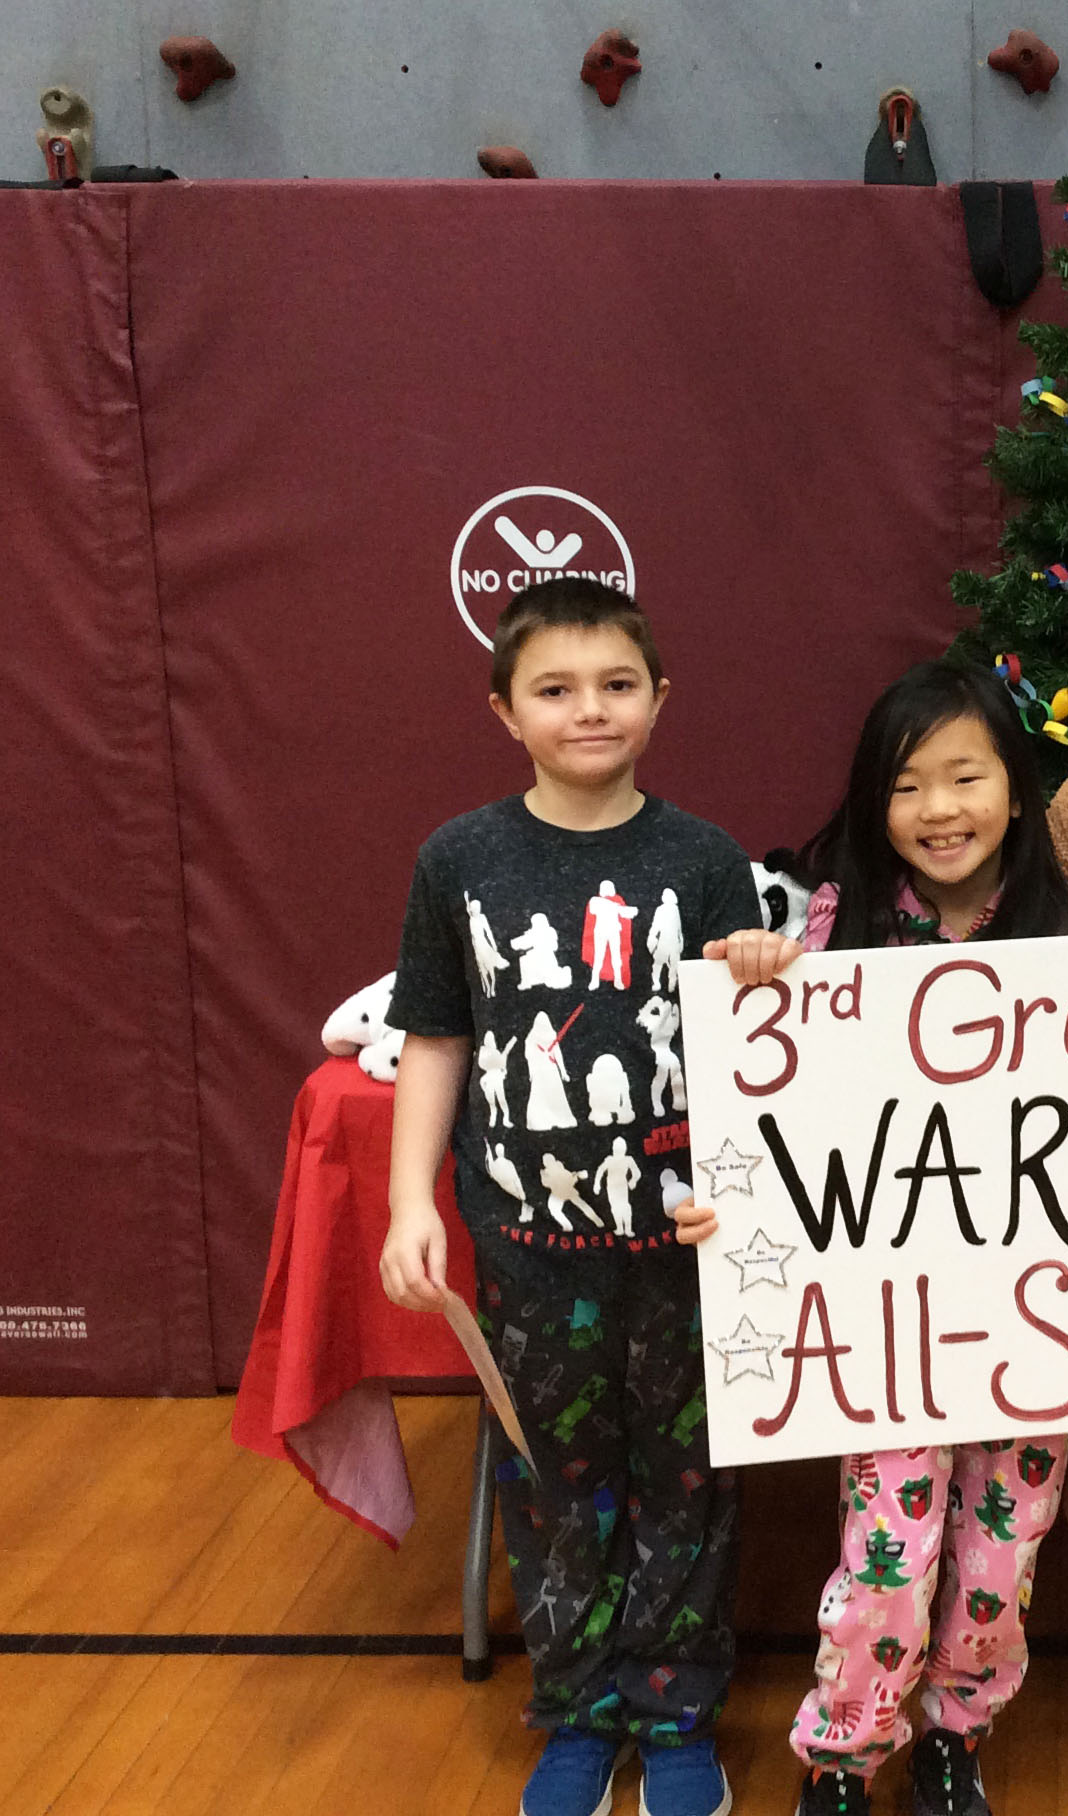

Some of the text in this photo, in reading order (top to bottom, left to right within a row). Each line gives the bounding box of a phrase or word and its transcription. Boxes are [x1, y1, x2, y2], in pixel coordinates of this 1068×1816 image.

[461, 569, 500, 593] NO
[731, 963, 862, 1097] 3rd
[547, 1232, 615, 1250] FORCE
